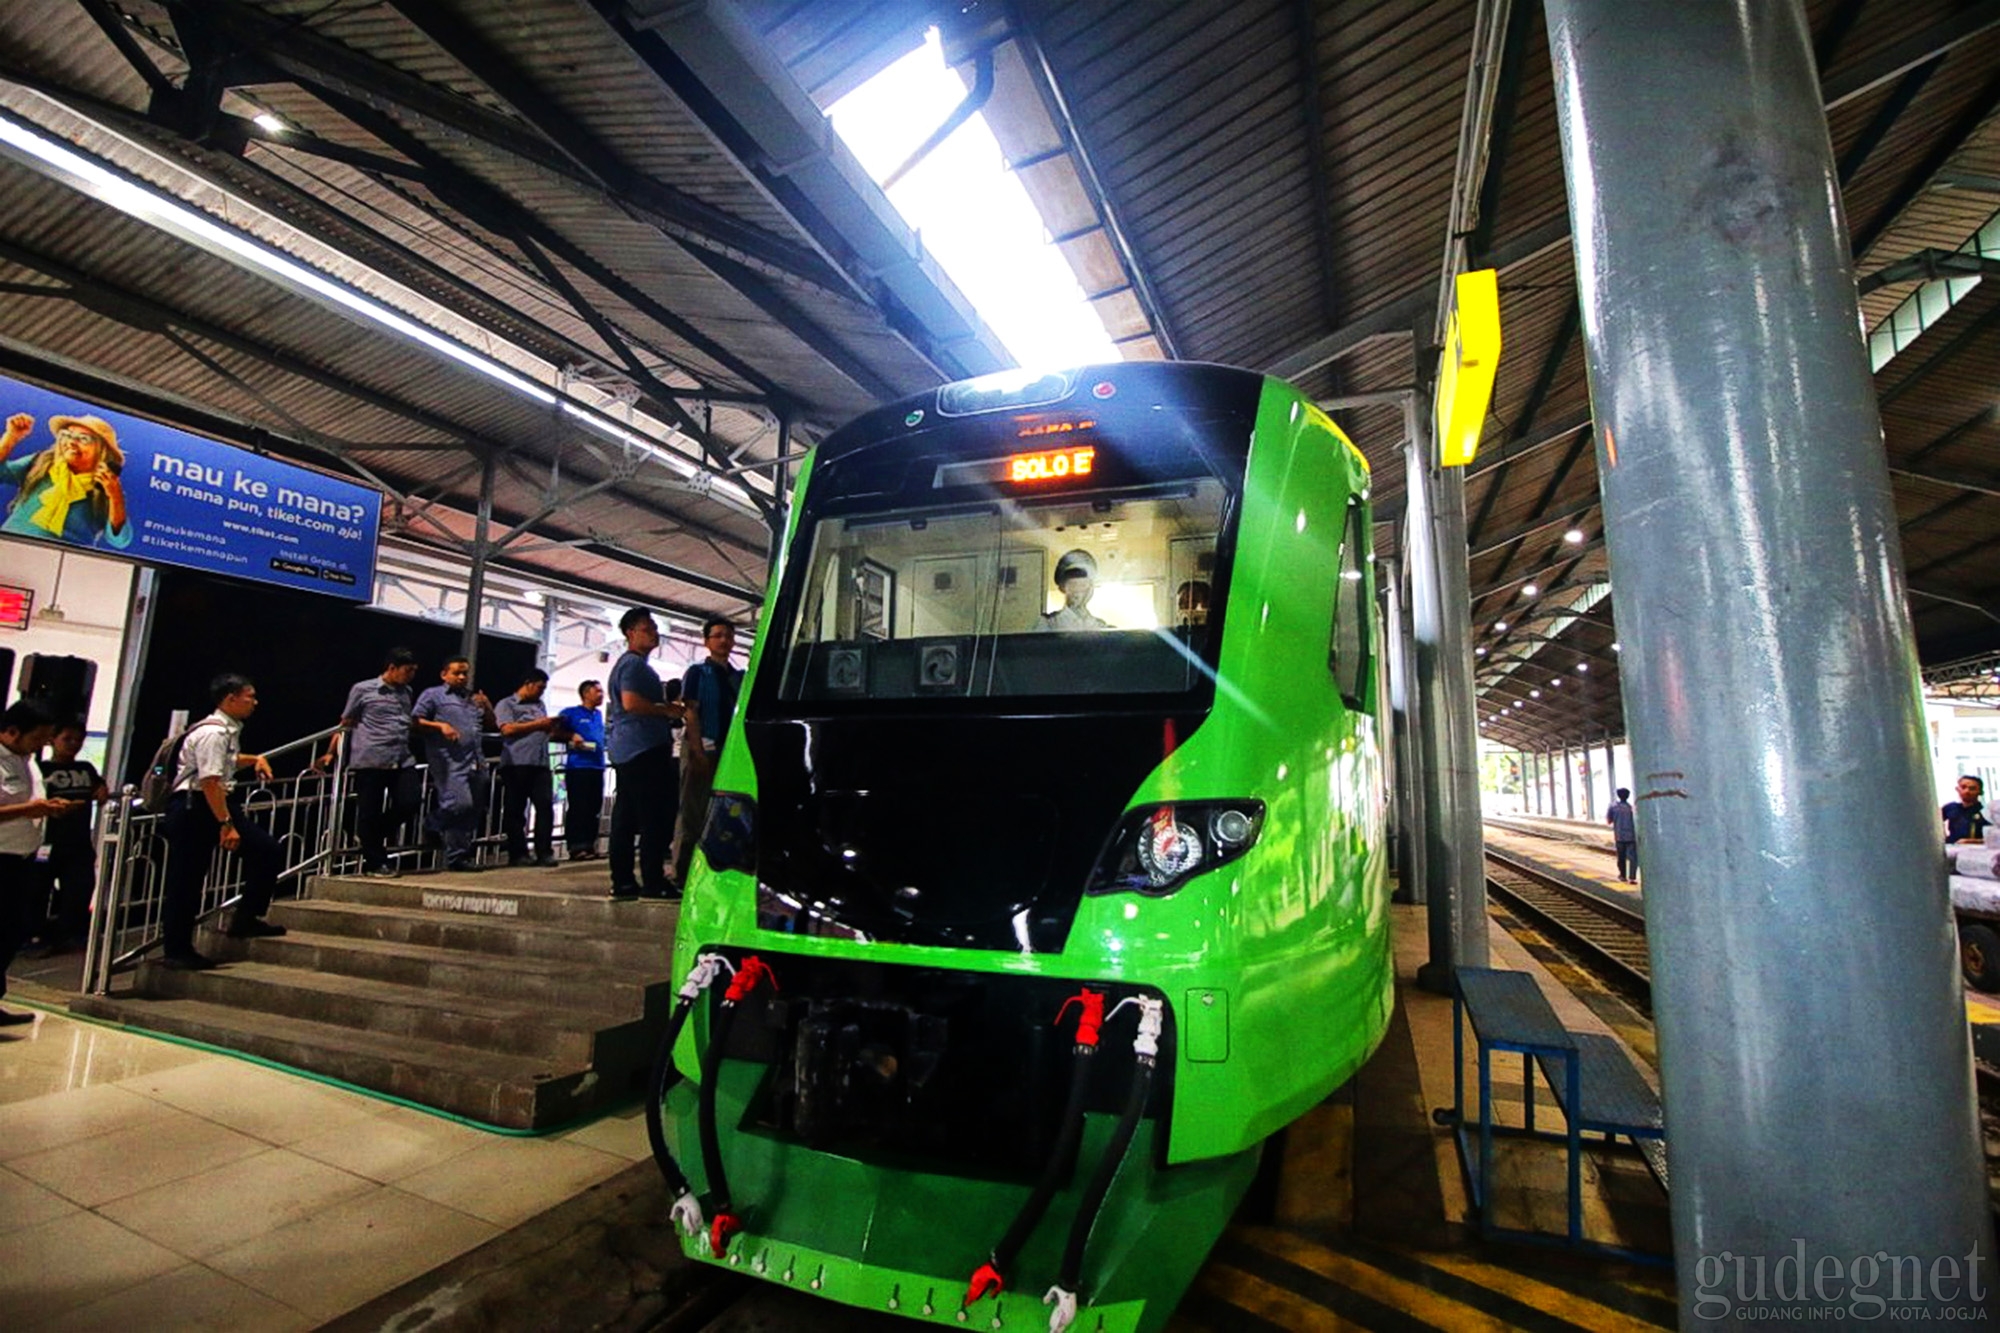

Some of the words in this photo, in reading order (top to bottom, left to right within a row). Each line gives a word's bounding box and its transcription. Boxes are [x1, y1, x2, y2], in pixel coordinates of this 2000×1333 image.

[1012, 455, 1069, 481] SOLO
[152, 453, 224, 488] mau
[233, 470, 269, 498] ke
[277, 487, 365, 524] mana?
[149, 476, 173, 492] ke
[176, 485, 223, 506] mana
[227, 498, 263, 518] pun,
[267, 506, 336, 534] tiket.com
[337, 527, 362, 541] aja!
[144, 520, 226, 545] #maukemana
[222, 520, 300, 545] www.tiket.com
[142, 534, 248, 564] #tiketkemanapun
